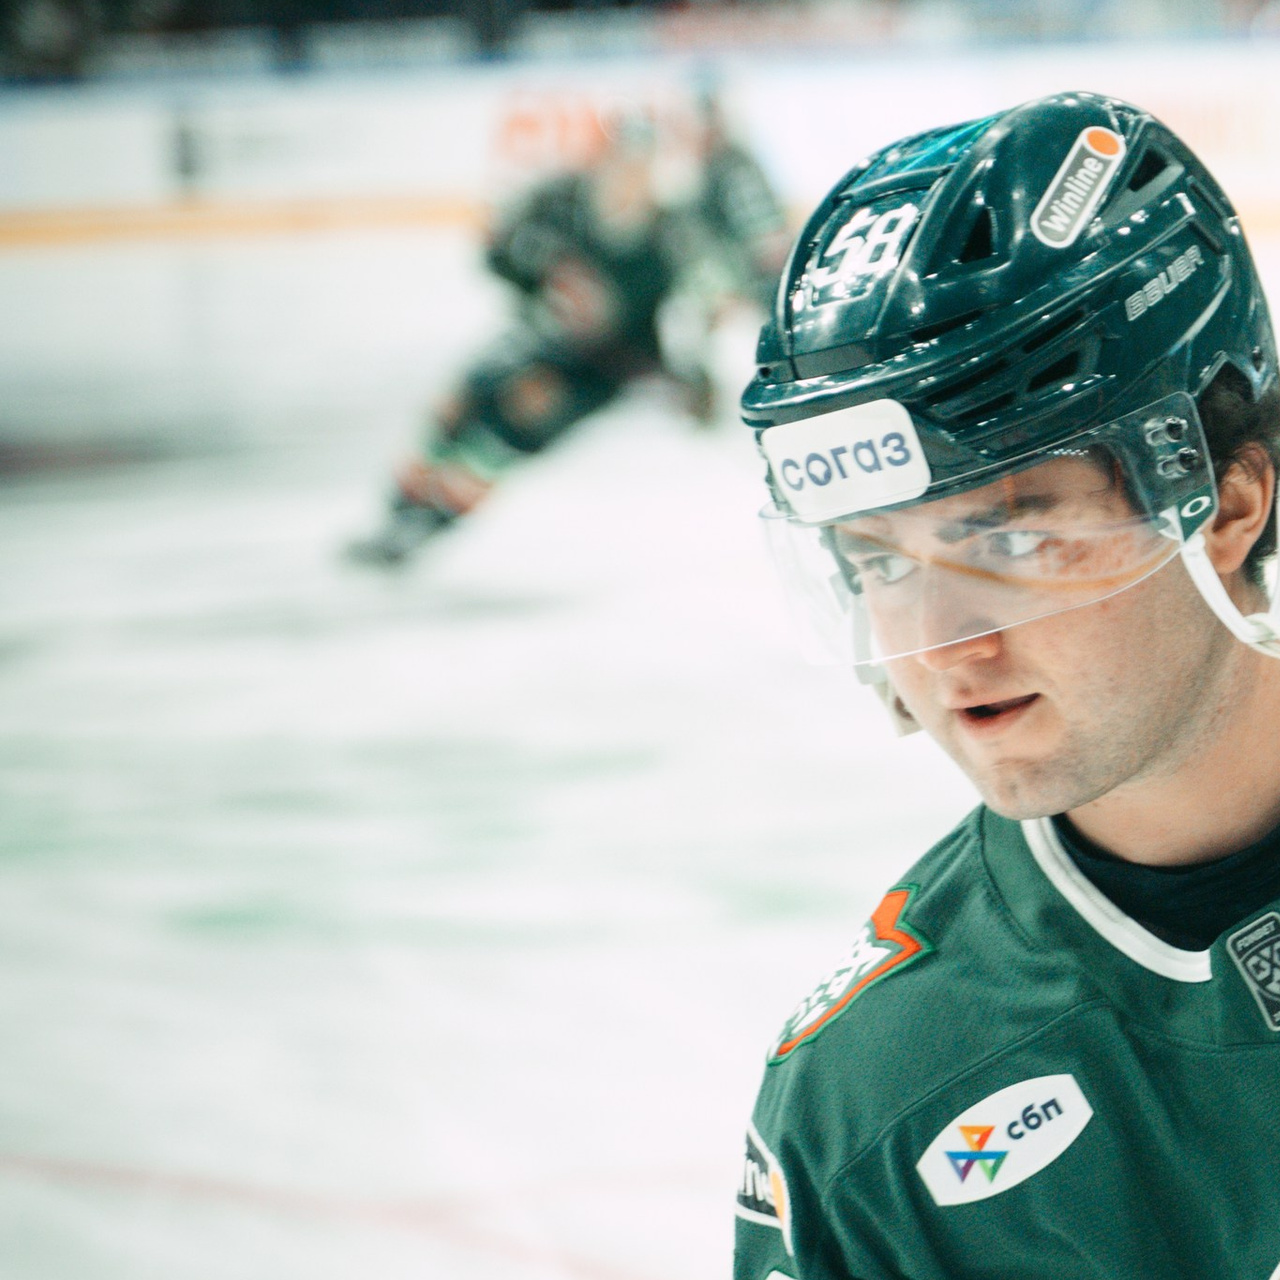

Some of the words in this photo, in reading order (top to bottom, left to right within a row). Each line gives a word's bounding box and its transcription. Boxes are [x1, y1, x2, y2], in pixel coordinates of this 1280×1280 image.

[1040, 157, 1104, 233] Winline
[808, 202, 920, 290] 58
[781, 431, 912, 492] согаз
[1006, 1097, 1064, 1141] сбп
